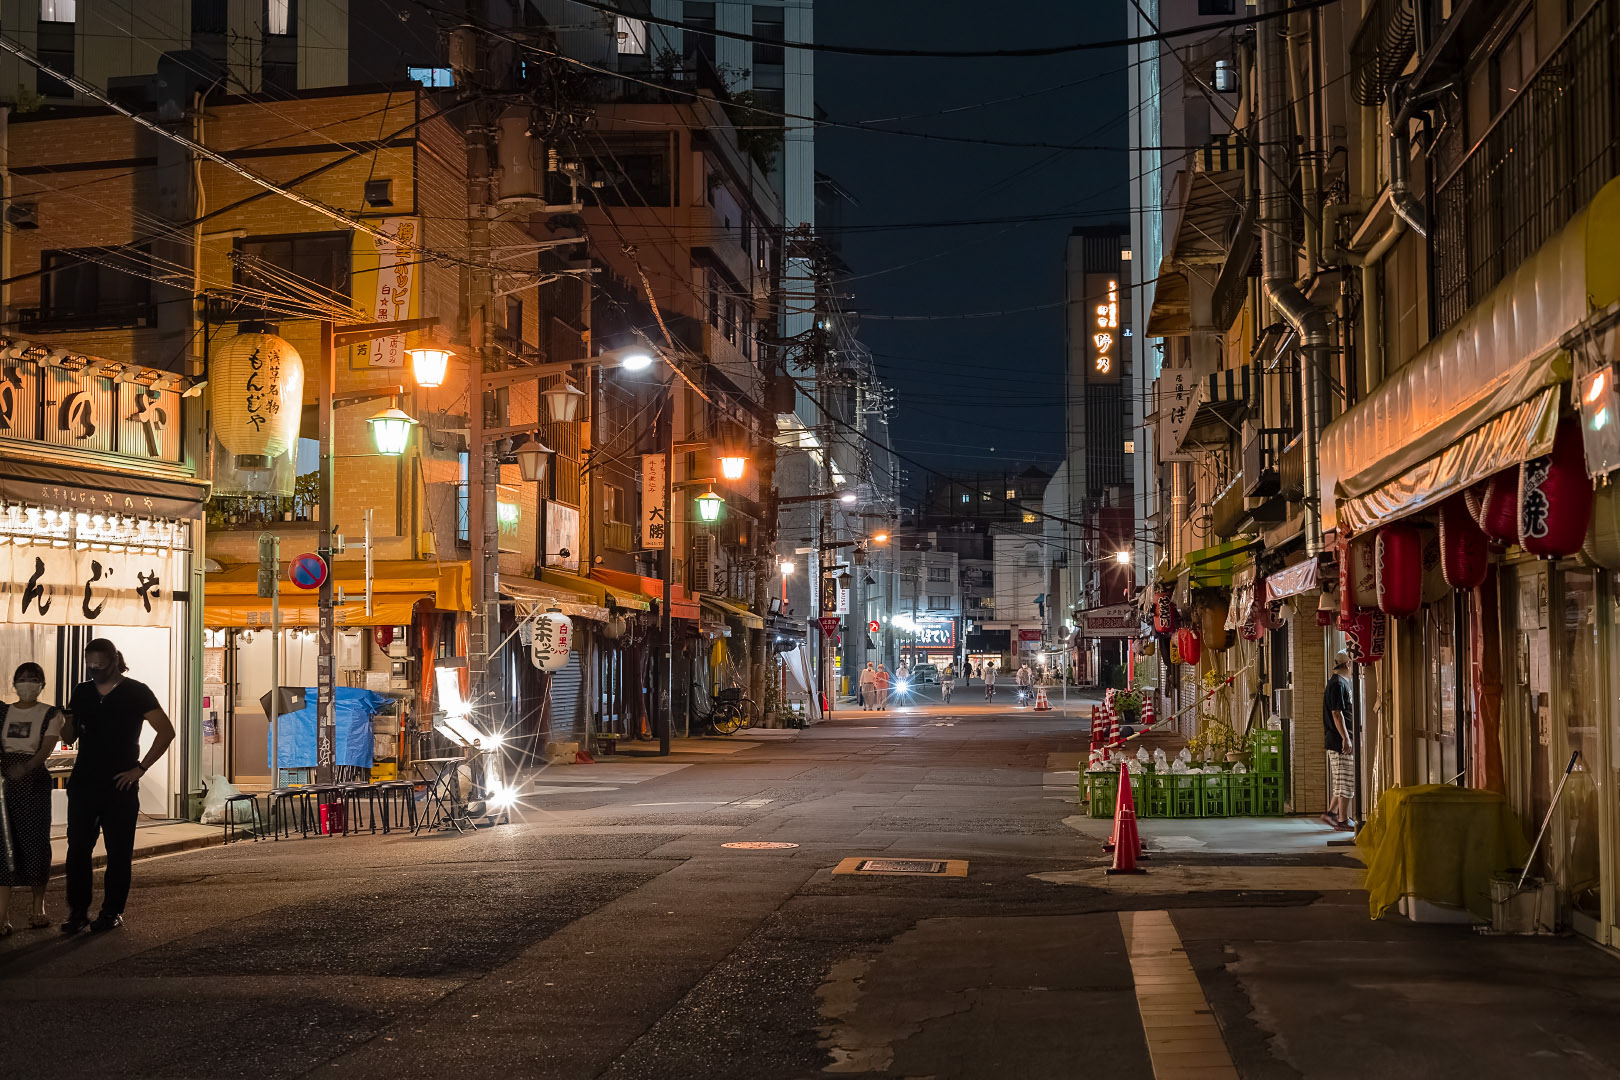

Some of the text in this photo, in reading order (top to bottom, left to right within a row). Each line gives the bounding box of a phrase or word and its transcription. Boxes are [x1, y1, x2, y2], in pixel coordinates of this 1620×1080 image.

[265, 348, 281, 416] 浅草名物
[1174, 374, 1185, 401] 居酒屋
[649, 505, 665, 540] 大勝
[534, 615, 555, 668] 生ホッピー
